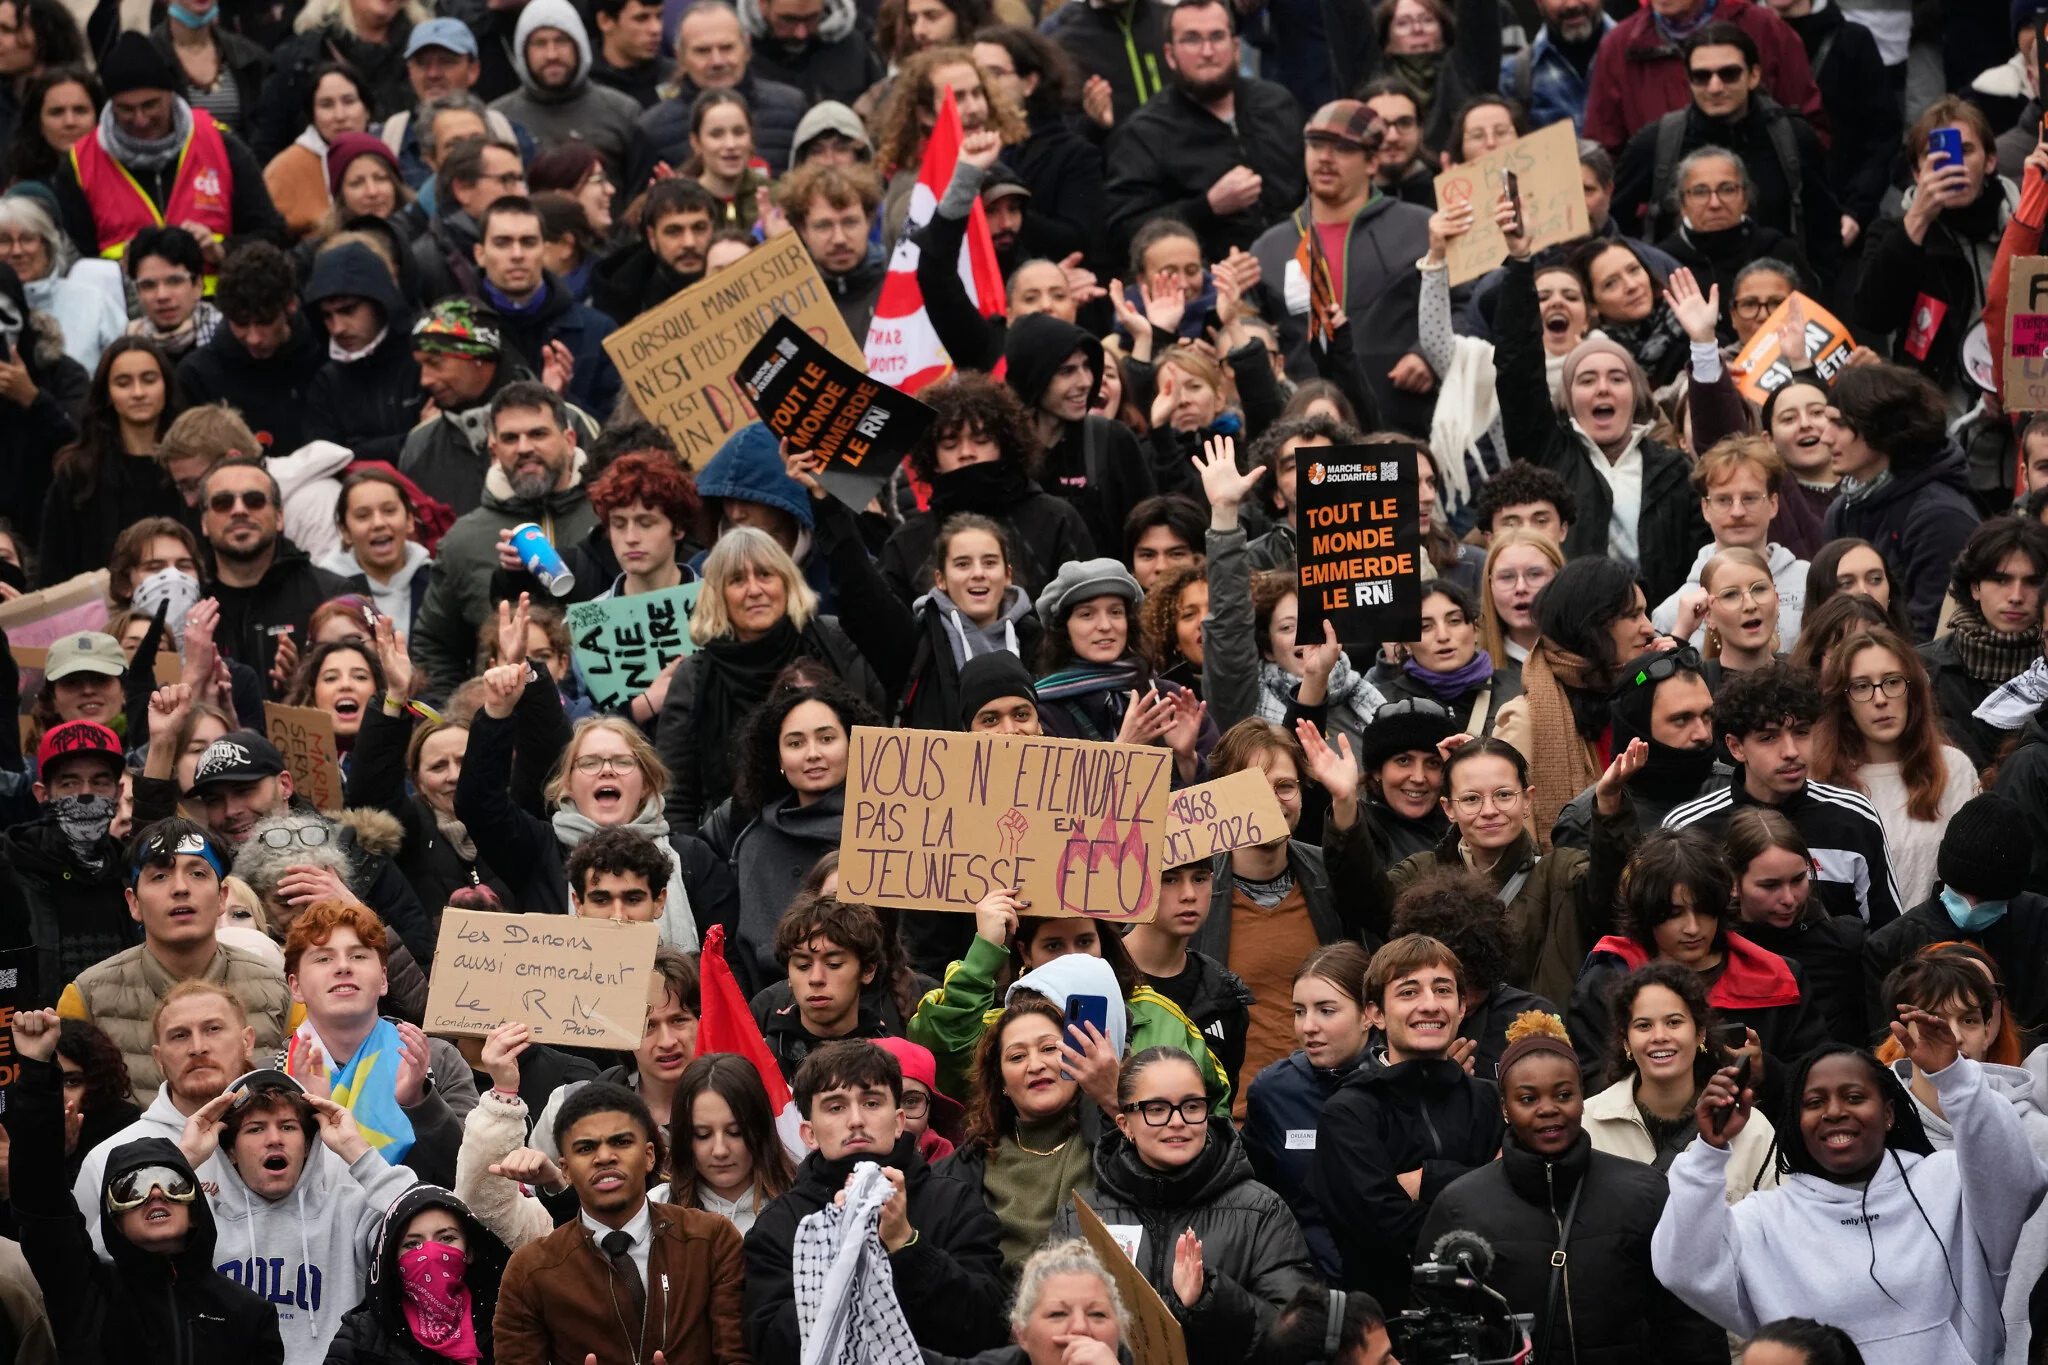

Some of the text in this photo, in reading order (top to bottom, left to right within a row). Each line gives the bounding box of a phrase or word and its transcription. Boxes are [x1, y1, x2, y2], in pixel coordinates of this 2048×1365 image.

[617, 308, 699, 370] LORSQUE
[701, 246, 808, 320] MANIFESTER
[634, 353, 692, 405] N'EST
[691, 330, 737, 371] PLUS
[734, 314, 764, 345] UN
[757, 277, 820, 328] DROIT
[770, 385, 808, 434] TOUT
[798, 361, 828, 391] LE
[790, 380, 848, 449] MONDE
[811, 382, 880, 475] EMMERDE
[841, 407, 890, 467] LE RN
[1327, 463, 1362, 474] MARCHE
[1327, 471, 1378, 483] SOLIDARITÉS
[1306, 498, 1398, 528] TOUT LE
[1312, 527, 1395, 556] MONDE
[1301, 553, 1414, 587] EMMERDE
[1322, 584, 1391, 611] LE RN
[579, 625, 613, 676] LA
[308, 733, 329, 809] MARIN
[860, 735, 948, 801] VOUS
[856, 801, 954, 848] PAS LA
[1054, 817, 1087, 834] EN
[1172, 790, 1218, 826] 1968
[1207, 811, 1262, 854] 2026
[846, 848, 1036, 905] JEUNESSE
[1060, 839, 1150, 914] FEU
[457, 920, 490, 943] Les
[453, 953, 507, 974] aussi
[455, 981, 490, 1012] Le
[435, 1015, 507, 1032] Condamnat
[1841, 1217, 1860, 1226] only
[217, 1257, 322, 1311] POLO
